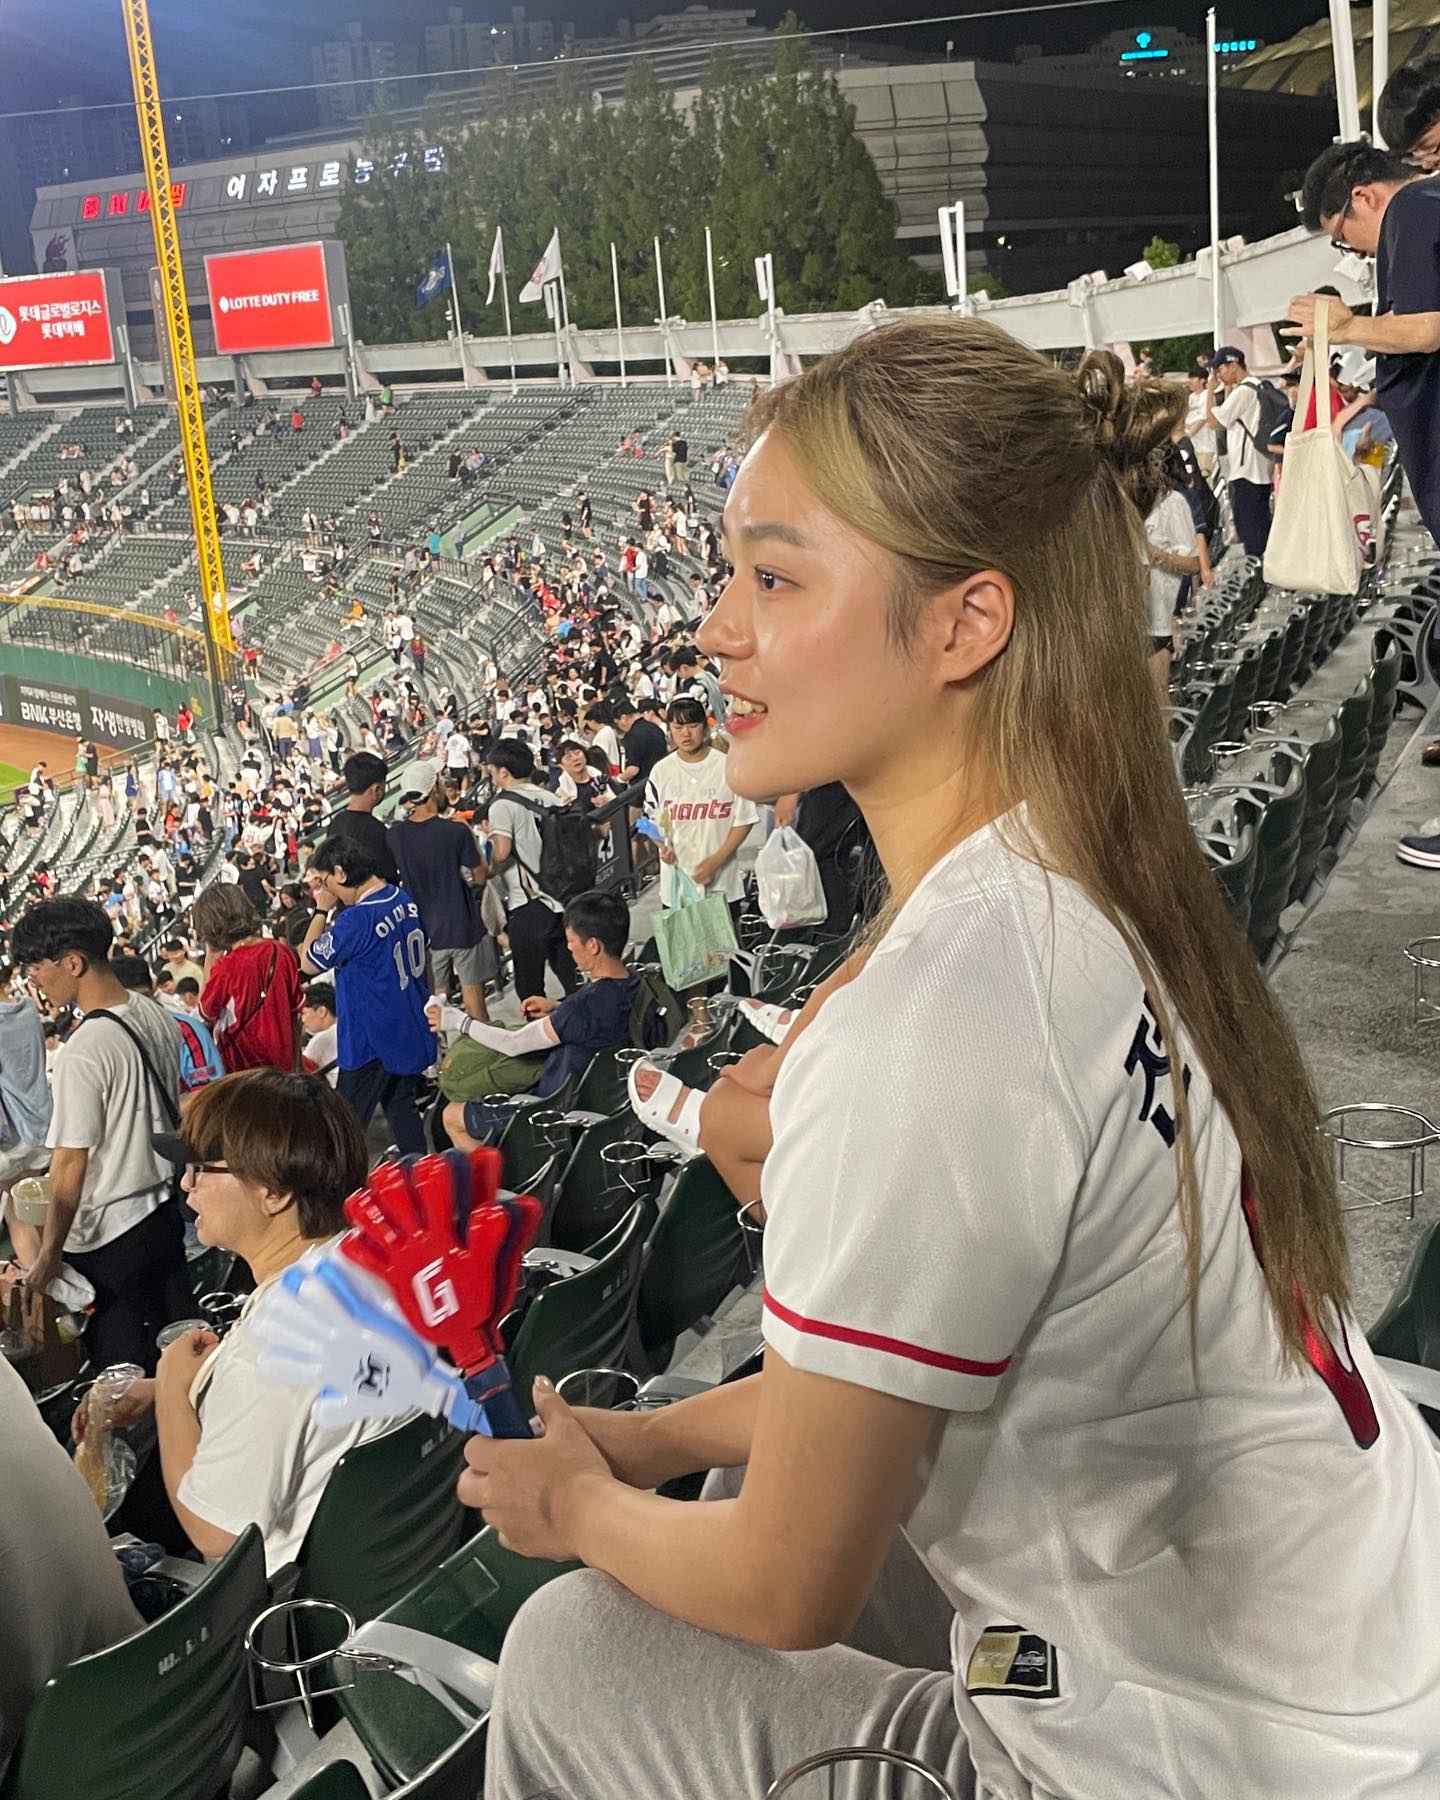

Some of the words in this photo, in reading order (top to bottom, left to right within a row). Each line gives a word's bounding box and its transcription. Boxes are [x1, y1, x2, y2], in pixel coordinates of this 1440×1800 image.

[19, 299, 103, 322] 롯데글로벌로지스
[229, 296, 262, 310] LOTTE
[261, 292, 291, 307] DUTY
[291, 289, 320, 304] FREE
[20, 701, 49, 725] BNK
[48, 706, 82, 732] 부산은행
[393, 928, 425, 991] 10
[412, 1256, 460, 1328] G
